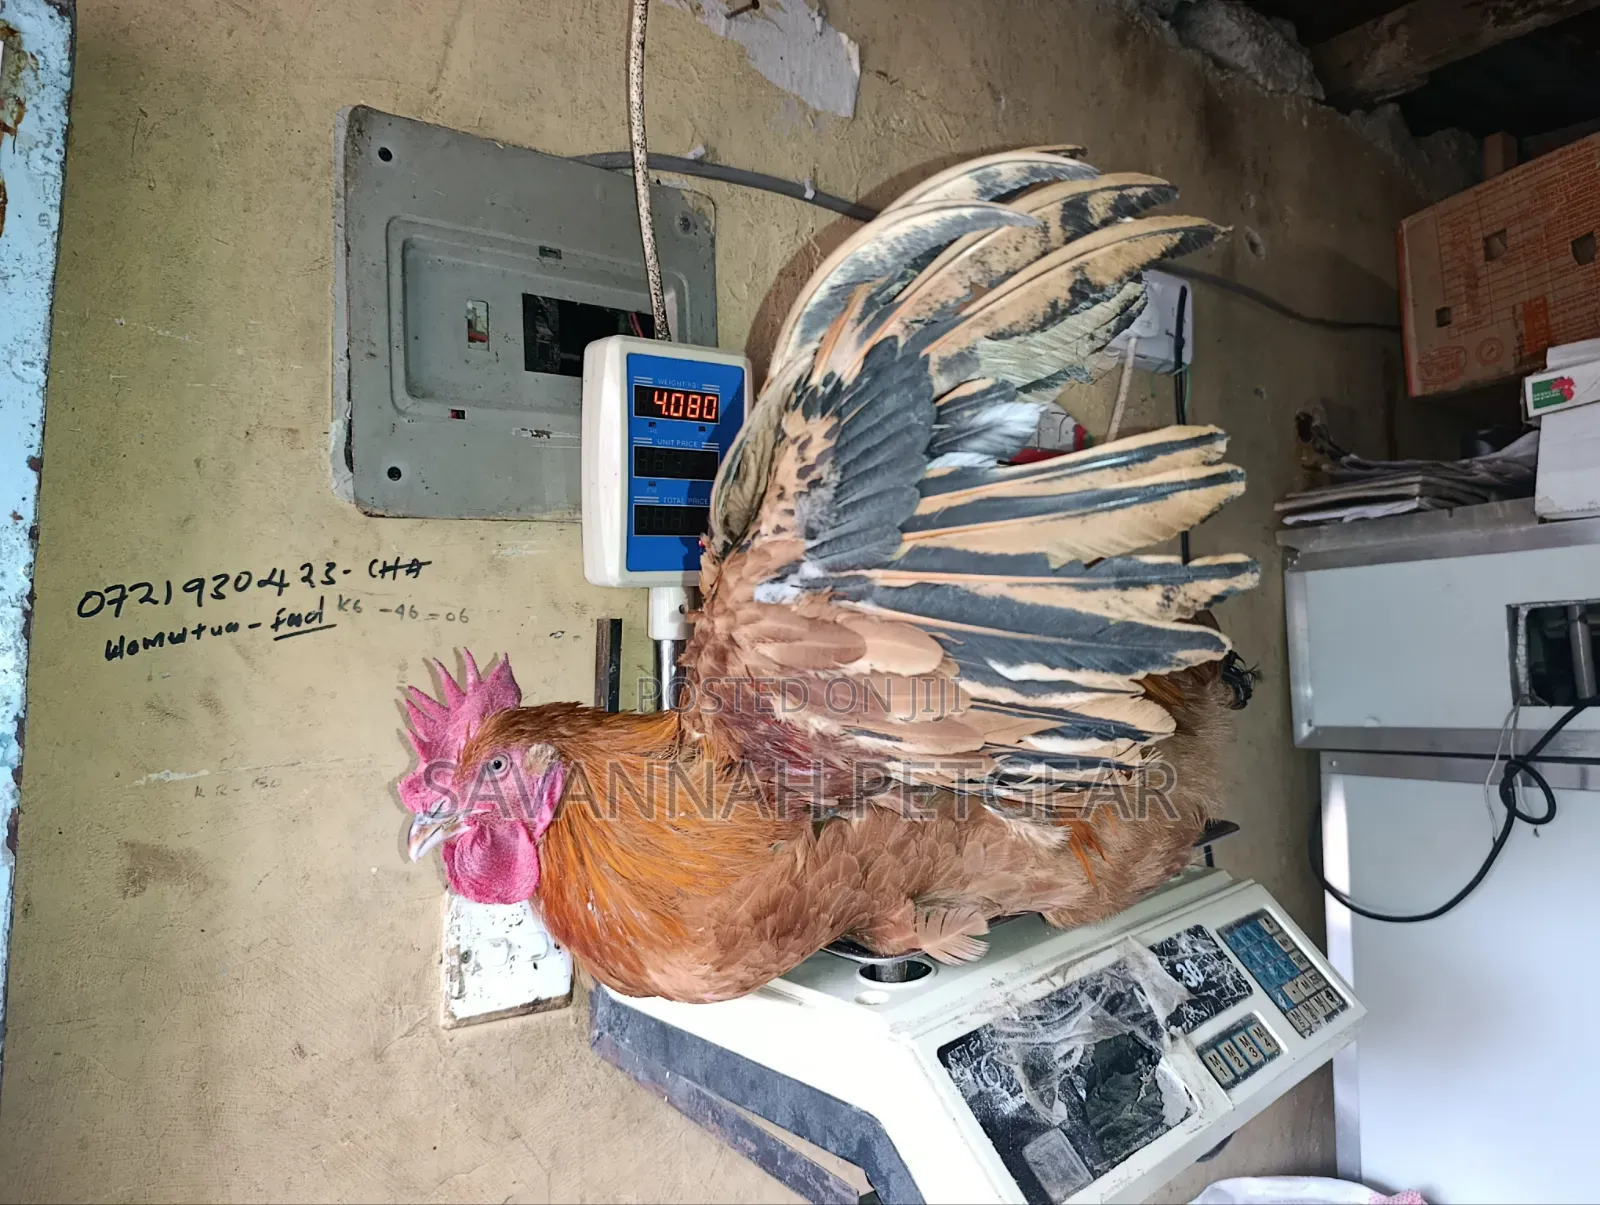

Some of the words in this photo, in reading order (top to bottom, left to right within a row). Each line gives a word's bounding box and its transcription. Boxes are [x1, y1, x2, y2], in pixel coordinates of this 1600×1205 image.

[653, 390, 717, 419] 4.080
[657, 438, 675, 446] UNIT
[676, 439, 698, 448] PRICE
[662, 497, 685, 505] TOTAL
[688, 498, 709, 506] PRICE
